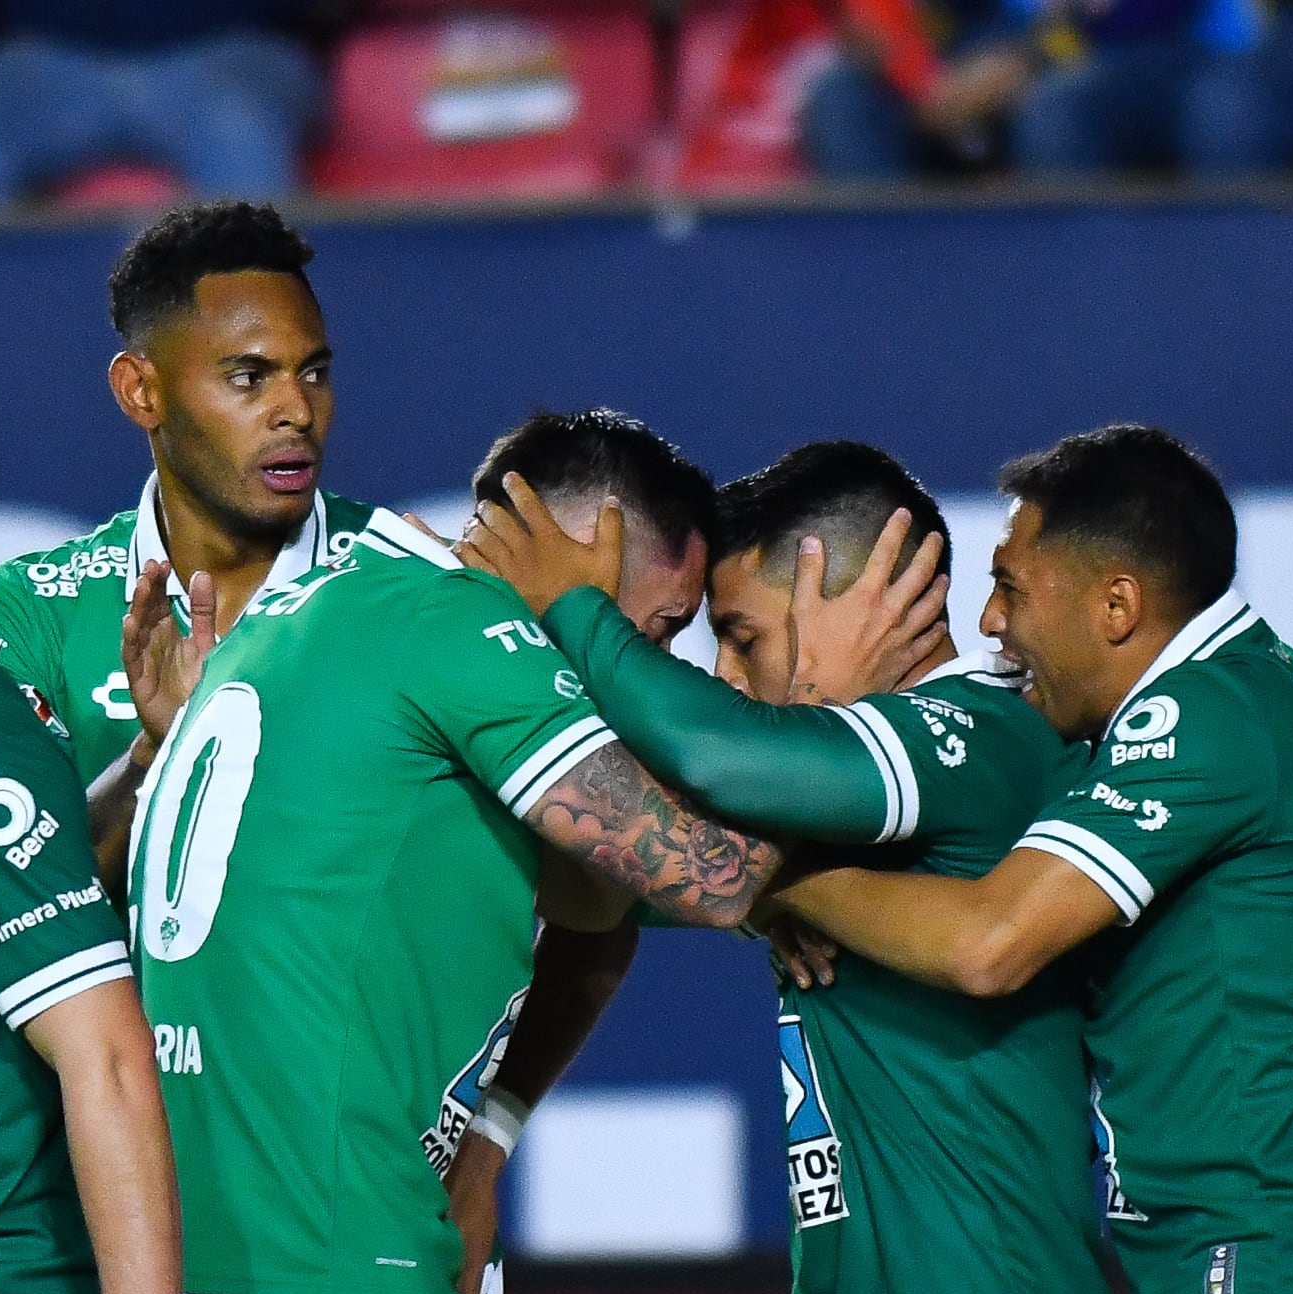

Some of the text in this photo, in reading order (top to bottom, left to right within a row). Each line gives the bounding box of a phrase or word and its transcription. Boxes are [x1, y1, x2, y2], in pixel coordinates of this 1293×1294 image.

[1111, 736, 1176, 766] Berel
[1090, 782, 1138, 812] Plus
[5, 809, 60, 871] Berel
[56, 885, 103, 911] Plus
